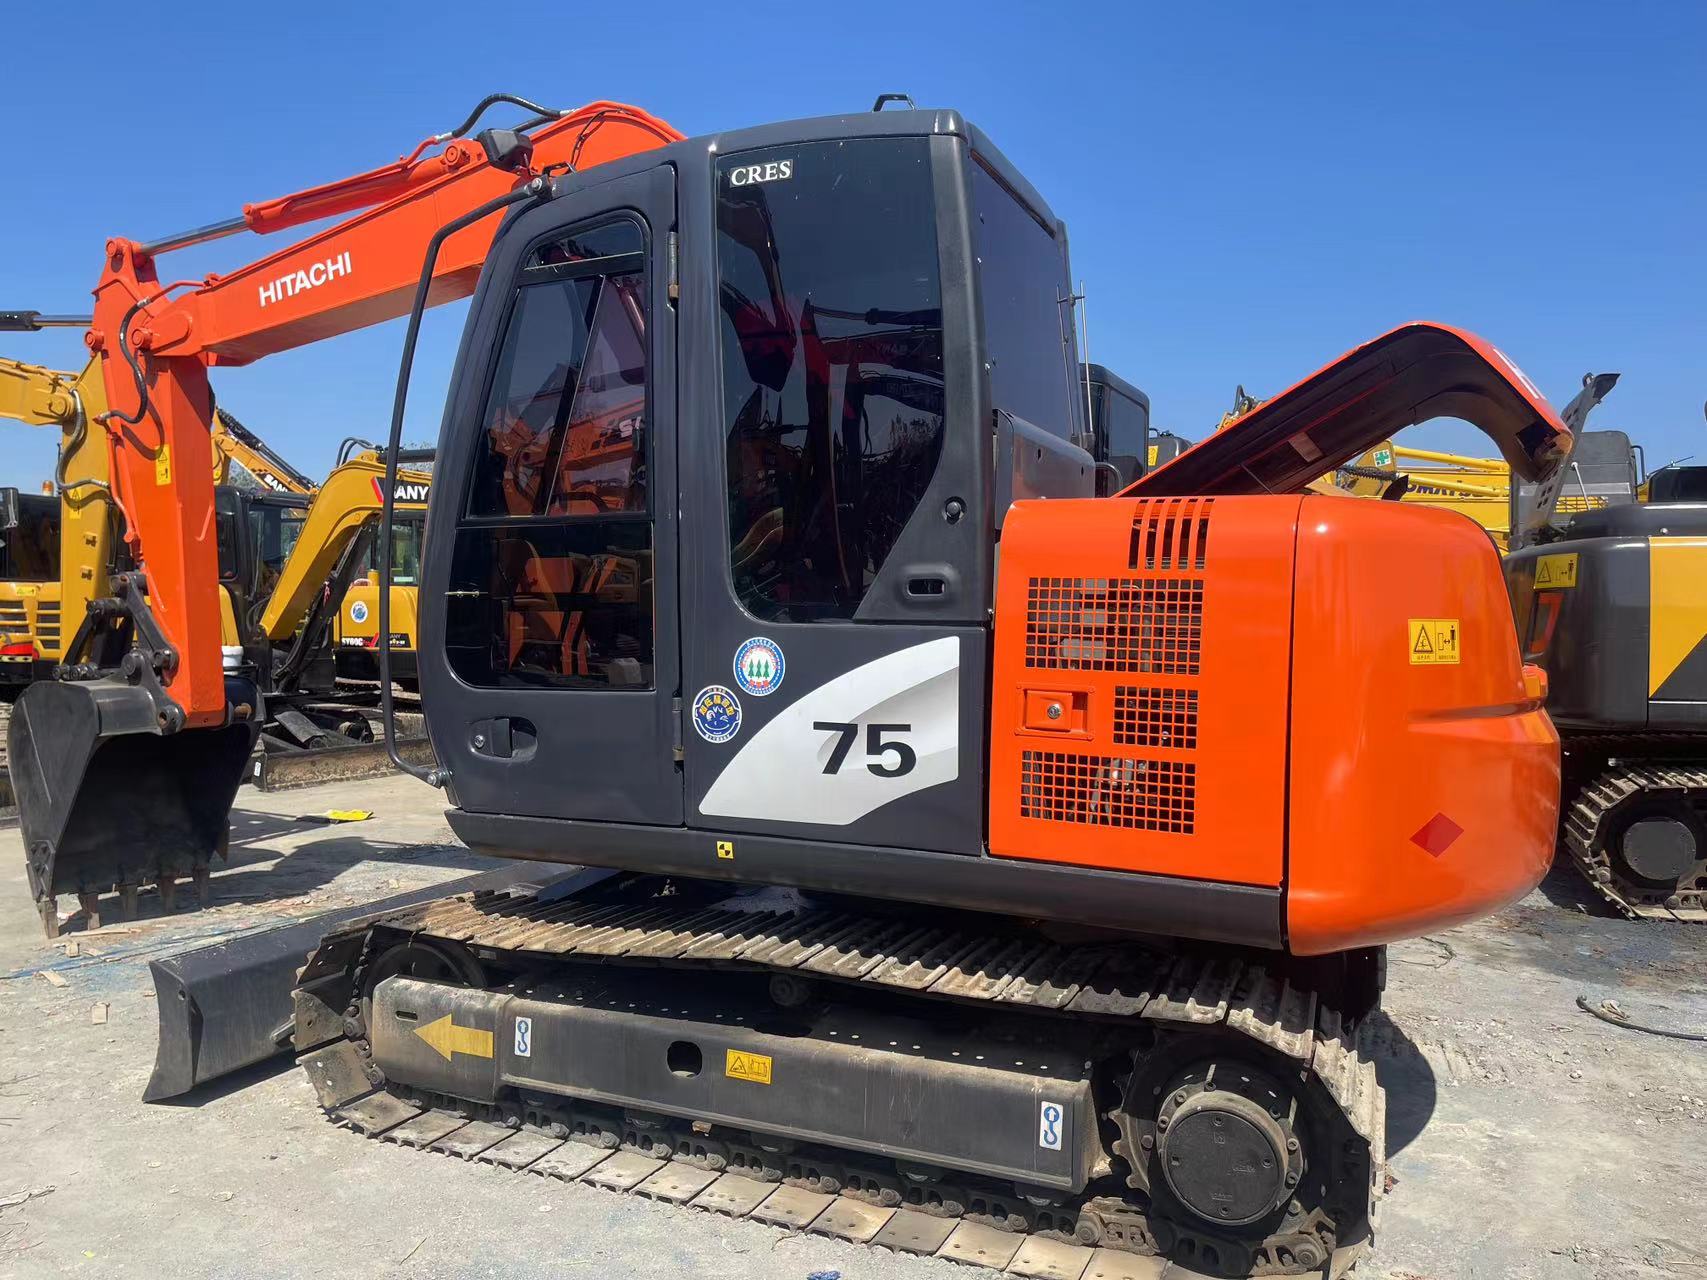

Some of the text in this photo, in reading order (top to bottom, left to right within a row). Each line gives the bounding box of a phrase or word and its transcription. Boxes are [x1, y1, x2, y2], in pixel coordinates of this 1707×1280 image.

[731, 160, 791, 186] CRES
[258, 251, 353, 308] HITACHI
[393, 485, 429, 501] ANY
[812, 721, 917, 778] 75
